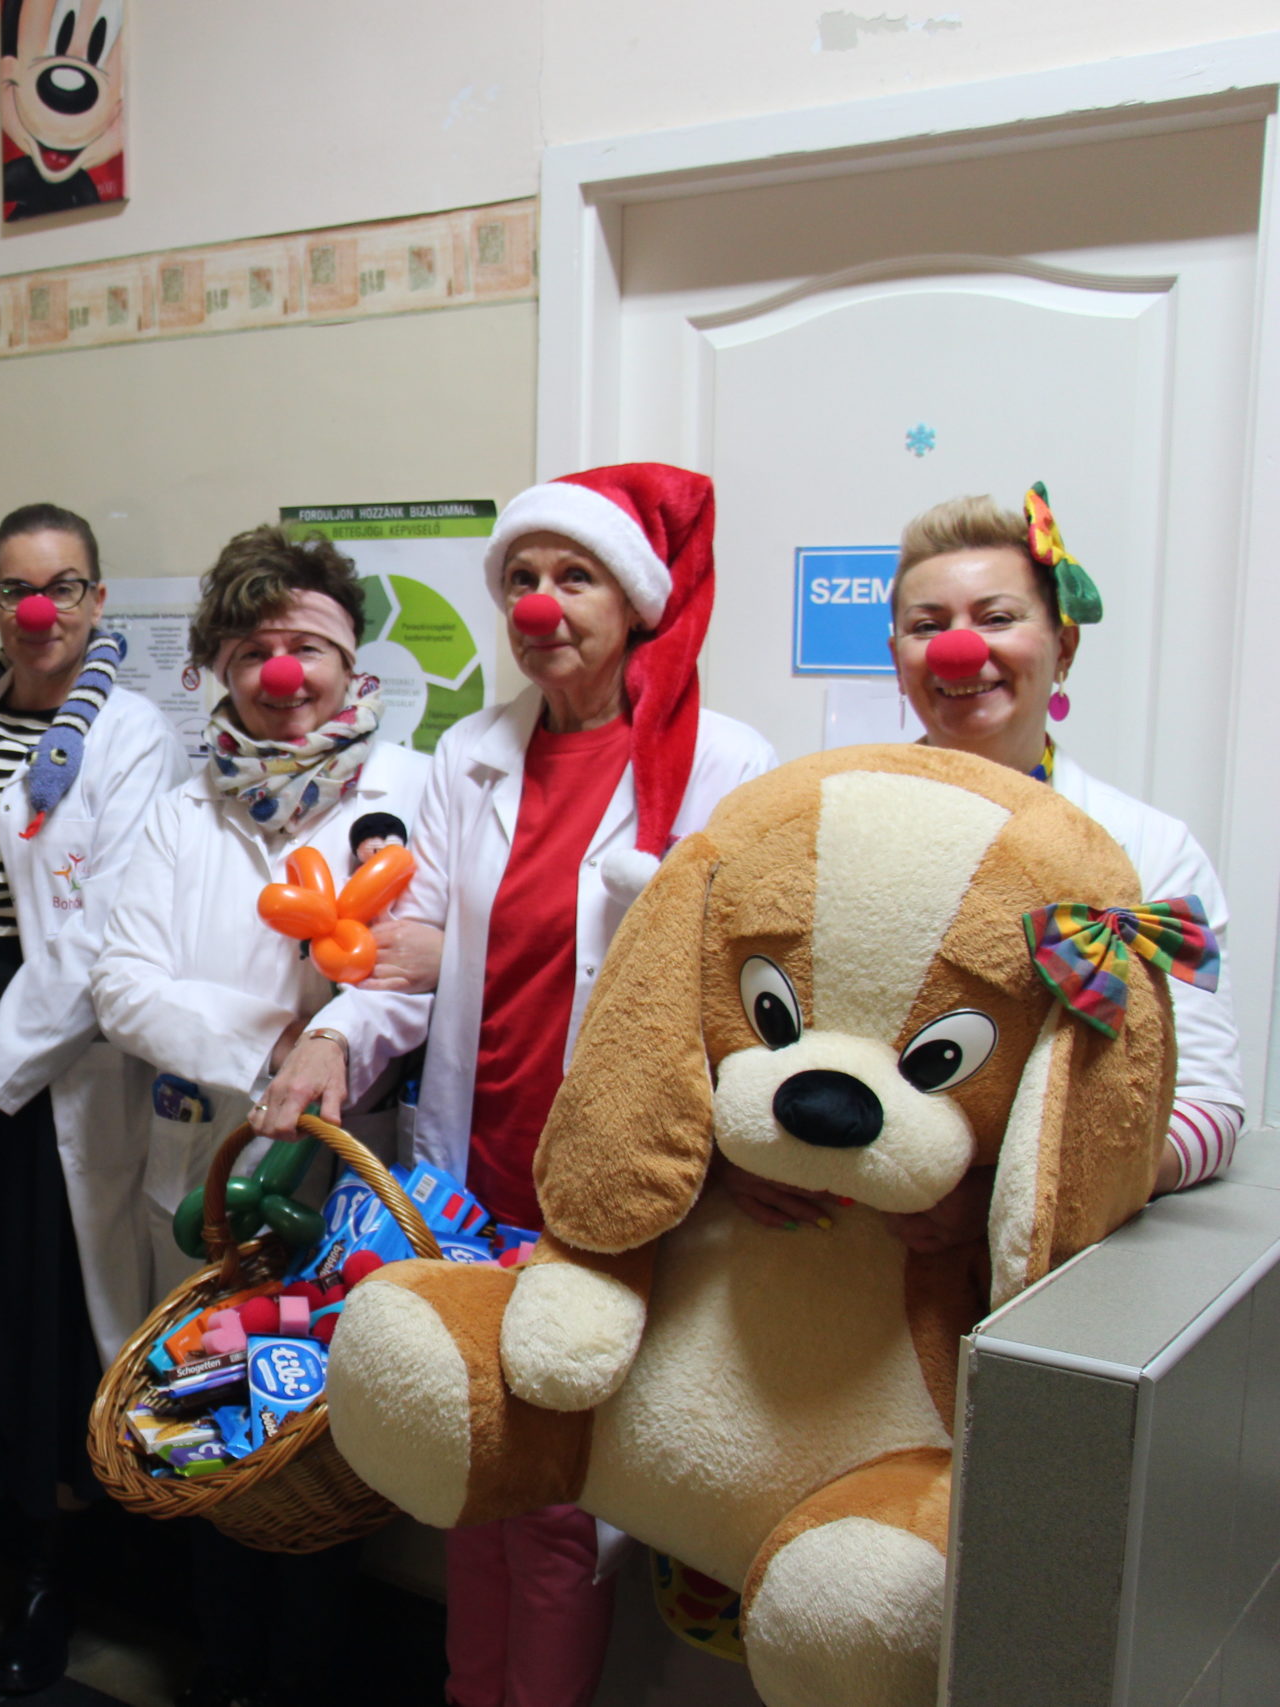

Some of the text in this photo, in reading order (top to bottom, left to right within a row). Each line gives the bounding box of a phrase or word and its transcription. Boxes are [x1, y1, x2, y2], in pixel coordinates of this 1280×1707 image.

[299, 504, 477, 521] FORDULJON HOZZÁNK BIZALOMMAL
[332, 525, 383, 538] BETEGJOGI
[176, 1358, 221, 1378] Schogetten
